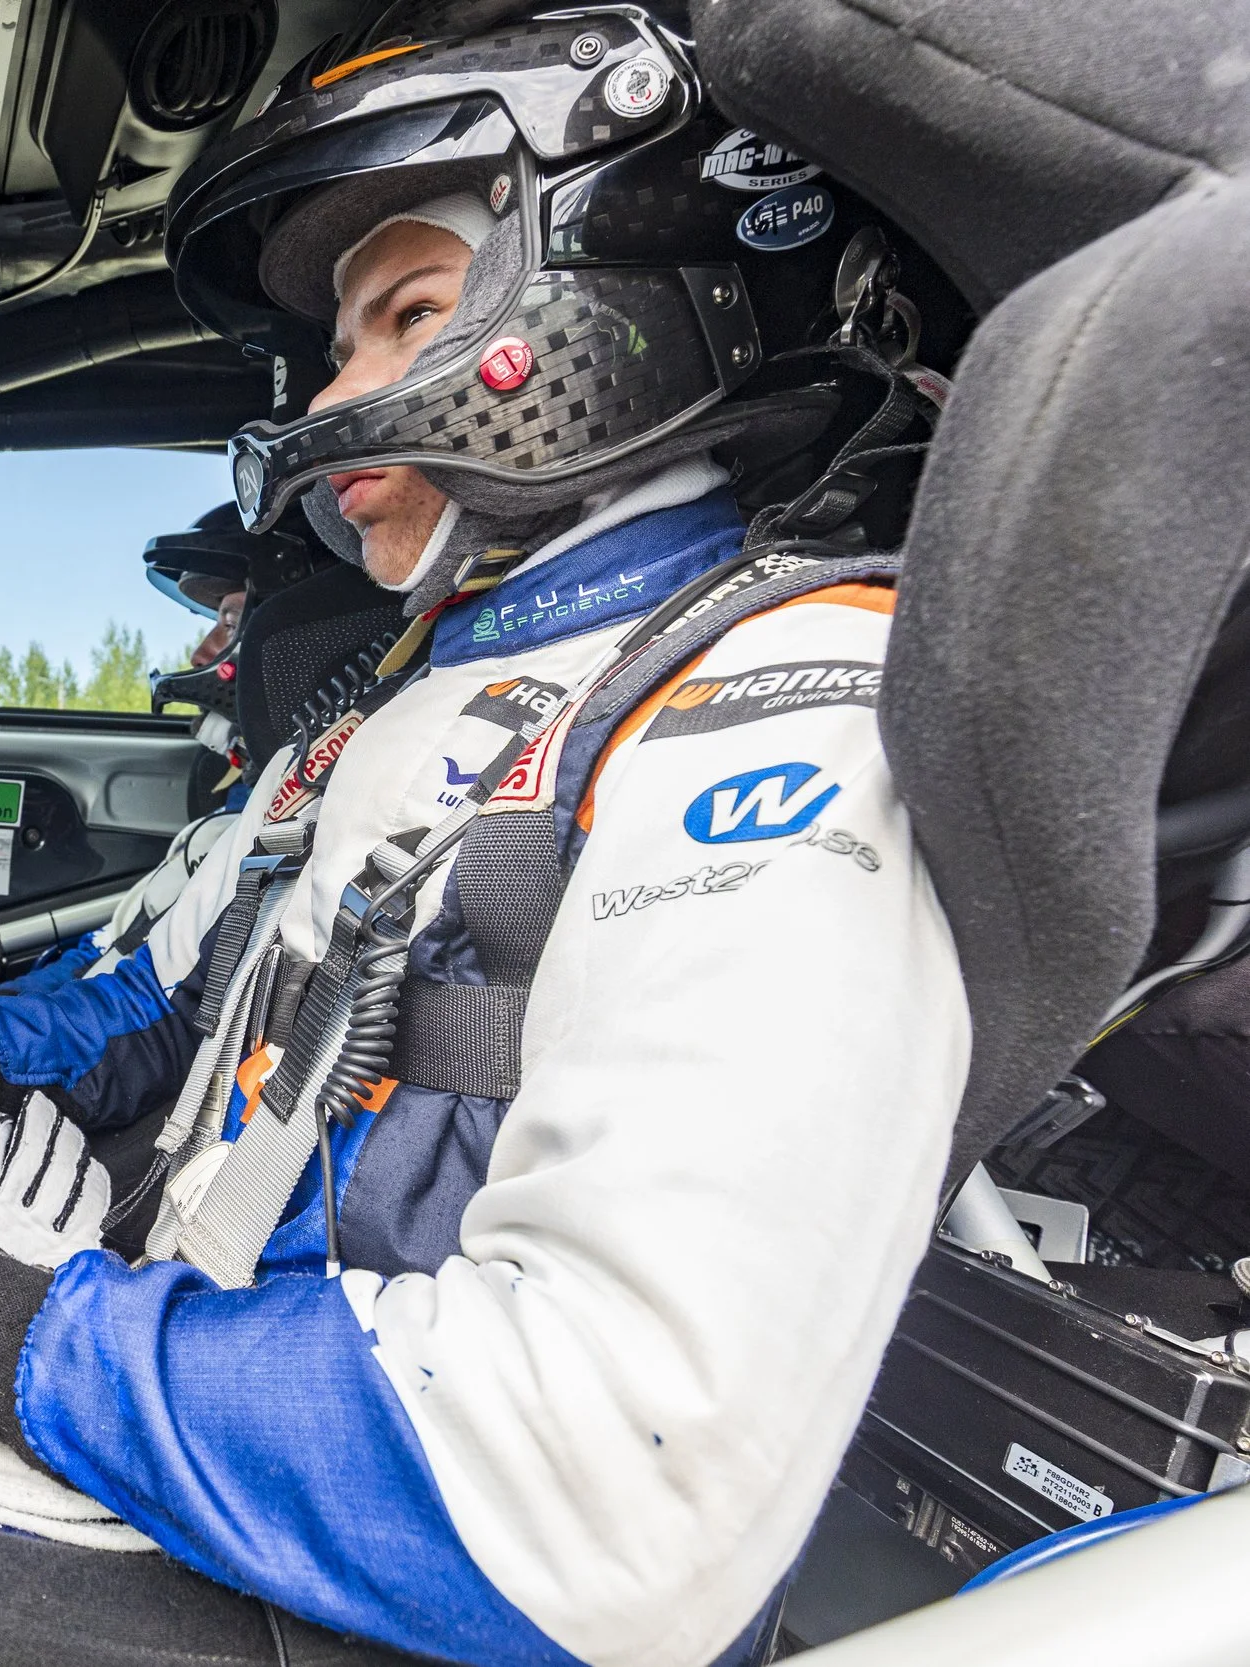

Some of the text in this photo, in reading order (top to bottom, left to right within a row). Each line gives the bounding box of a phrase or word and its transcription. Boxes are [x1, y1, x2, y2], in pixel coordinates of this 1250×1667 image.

[748, 170, 808, 187] SERIES
[792, 195, 823, 220] P40
[491, 357, 510, 379] LIFT
[501, 573, 643, 620] FULL
[503, 583, 645, 631] EFFICIENCY
[762, 688, 850, 710] driving
[1041, 1485, 1053, 1497] SN
[1093, 1503, 1103, 1517] B
